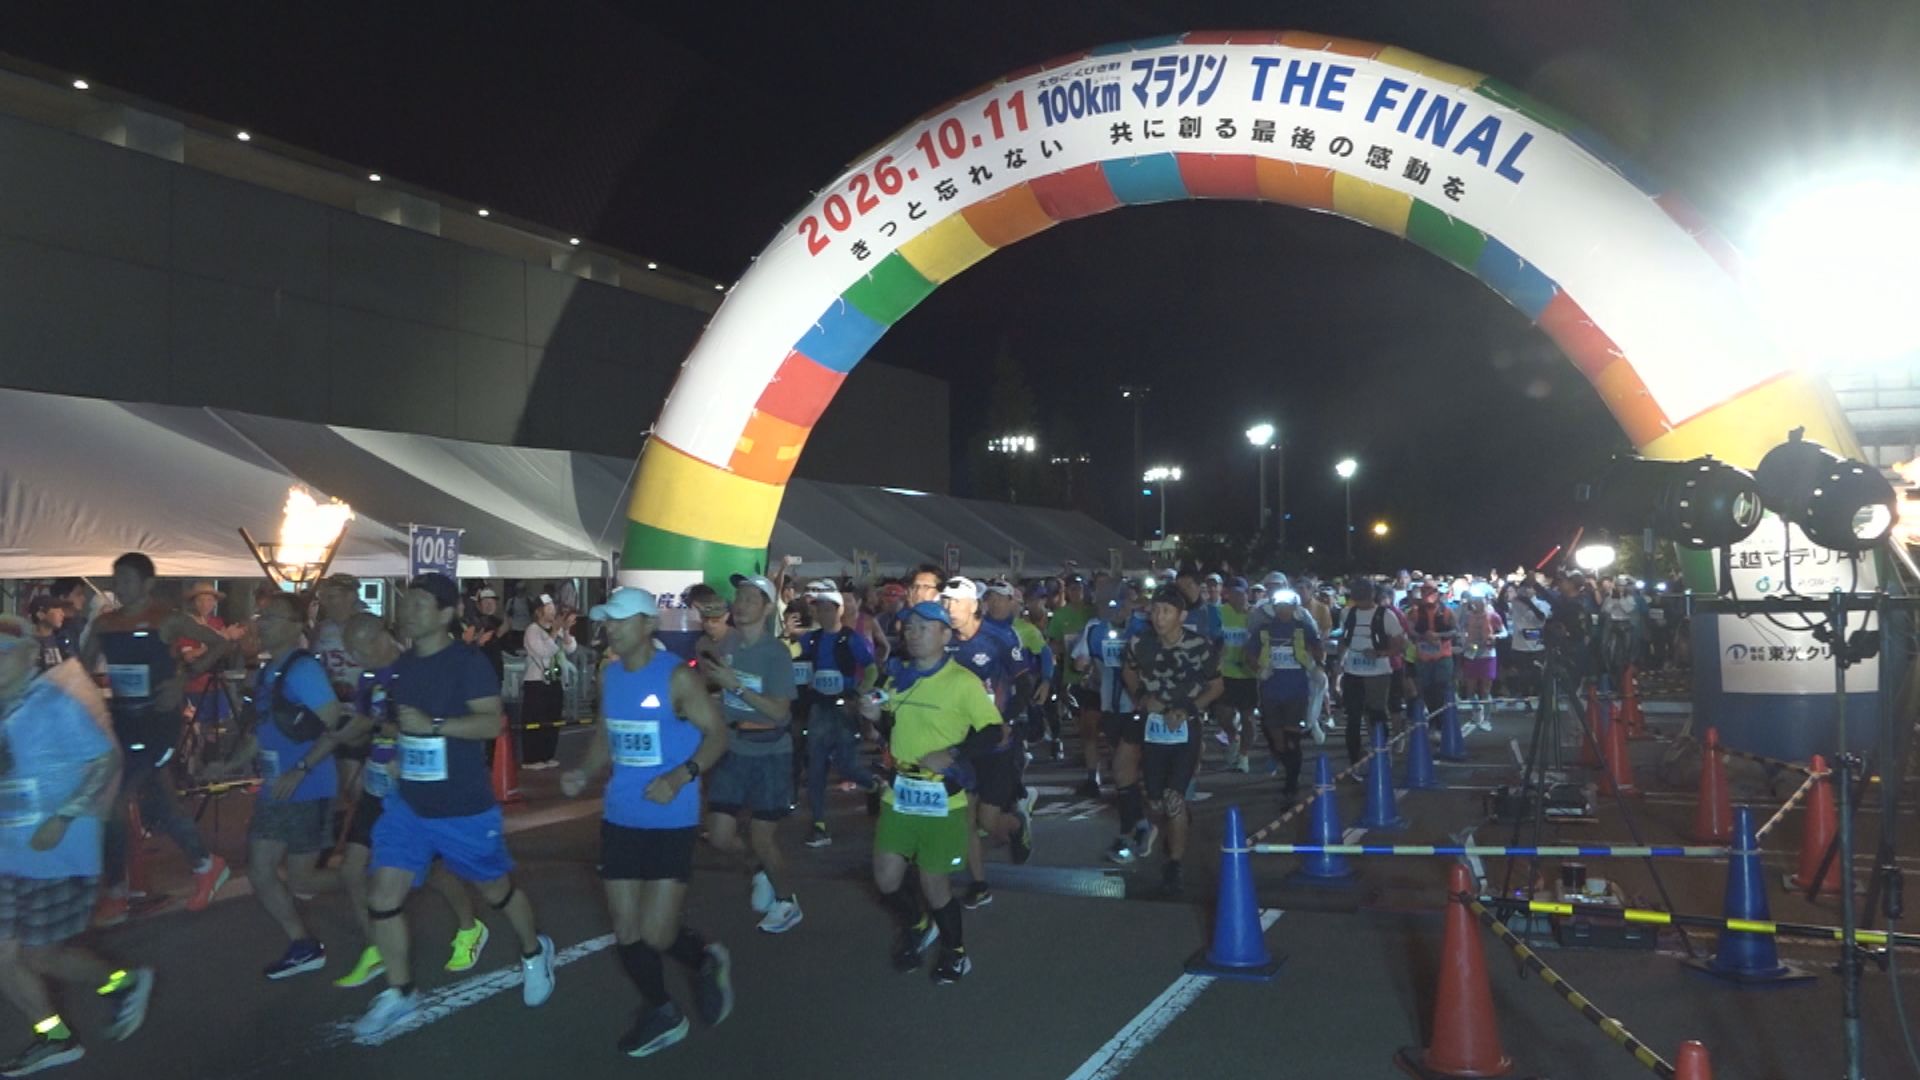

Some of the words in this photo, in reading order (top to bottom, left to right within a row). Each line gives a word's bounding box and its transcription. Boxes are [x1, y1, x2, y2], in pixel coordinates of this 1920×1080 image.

[798, 90, 1029, 256] 2026.10.11
[1037, 78, 1121, 127] 100km
[1131, 55, 1228, 109] マラソン
[1251, 57, 1355, 113] THE
[1364, 77, 1535, 184] FINAL
[850, 139, 1064, 261] きっと忘れない
[1109, 115, 1467, 202] 共に創る最後の感動を
[415, 535, 446, 565] 100
